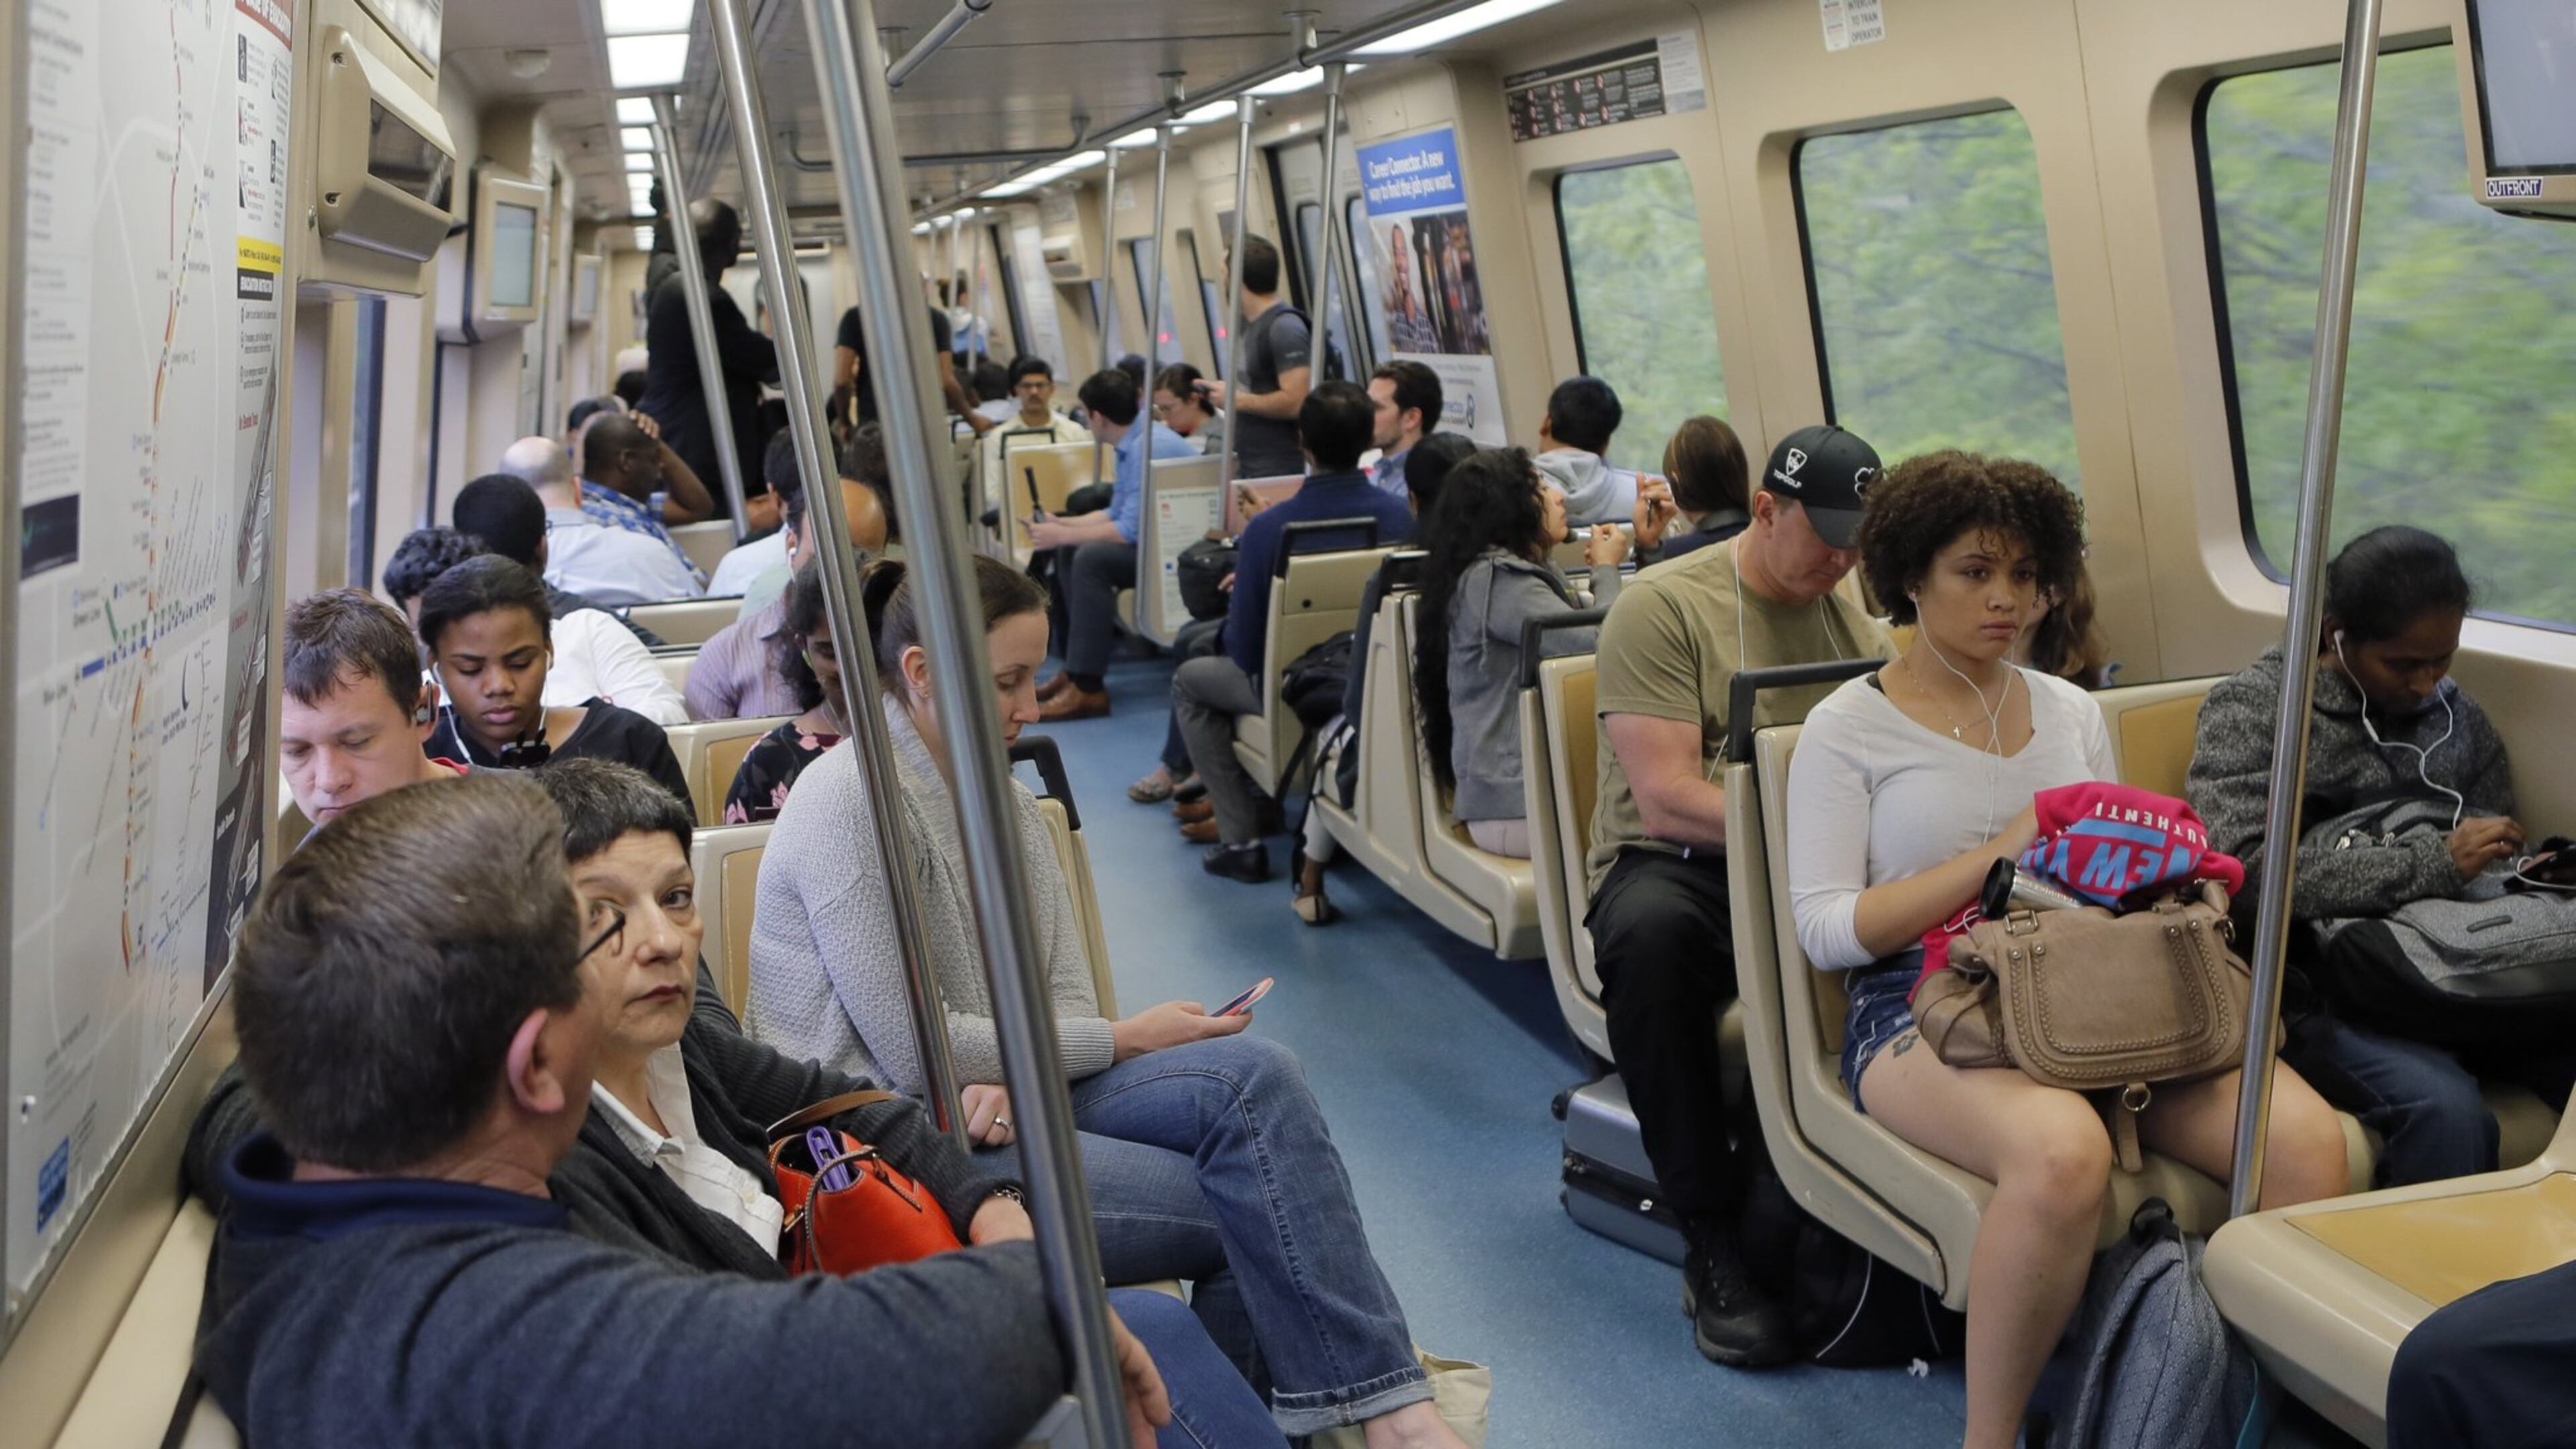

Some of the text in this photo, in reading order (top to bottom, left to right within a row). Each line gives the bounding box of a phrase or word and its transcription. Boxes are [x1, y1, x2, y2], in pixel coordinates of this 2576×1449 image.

[1861, 12, 1878, 24] TRAIN
[1851, 27, 1882, 43] OPERATOR
[1421, 149, 1430, 168] A
[1428, 151, 1444, 168] new
[2488, 180, 2539, 196] OUTFRONT
[1774, 468, 1802, 488] TOPGOLF
[2079, 841, 2202, 890] NEW
